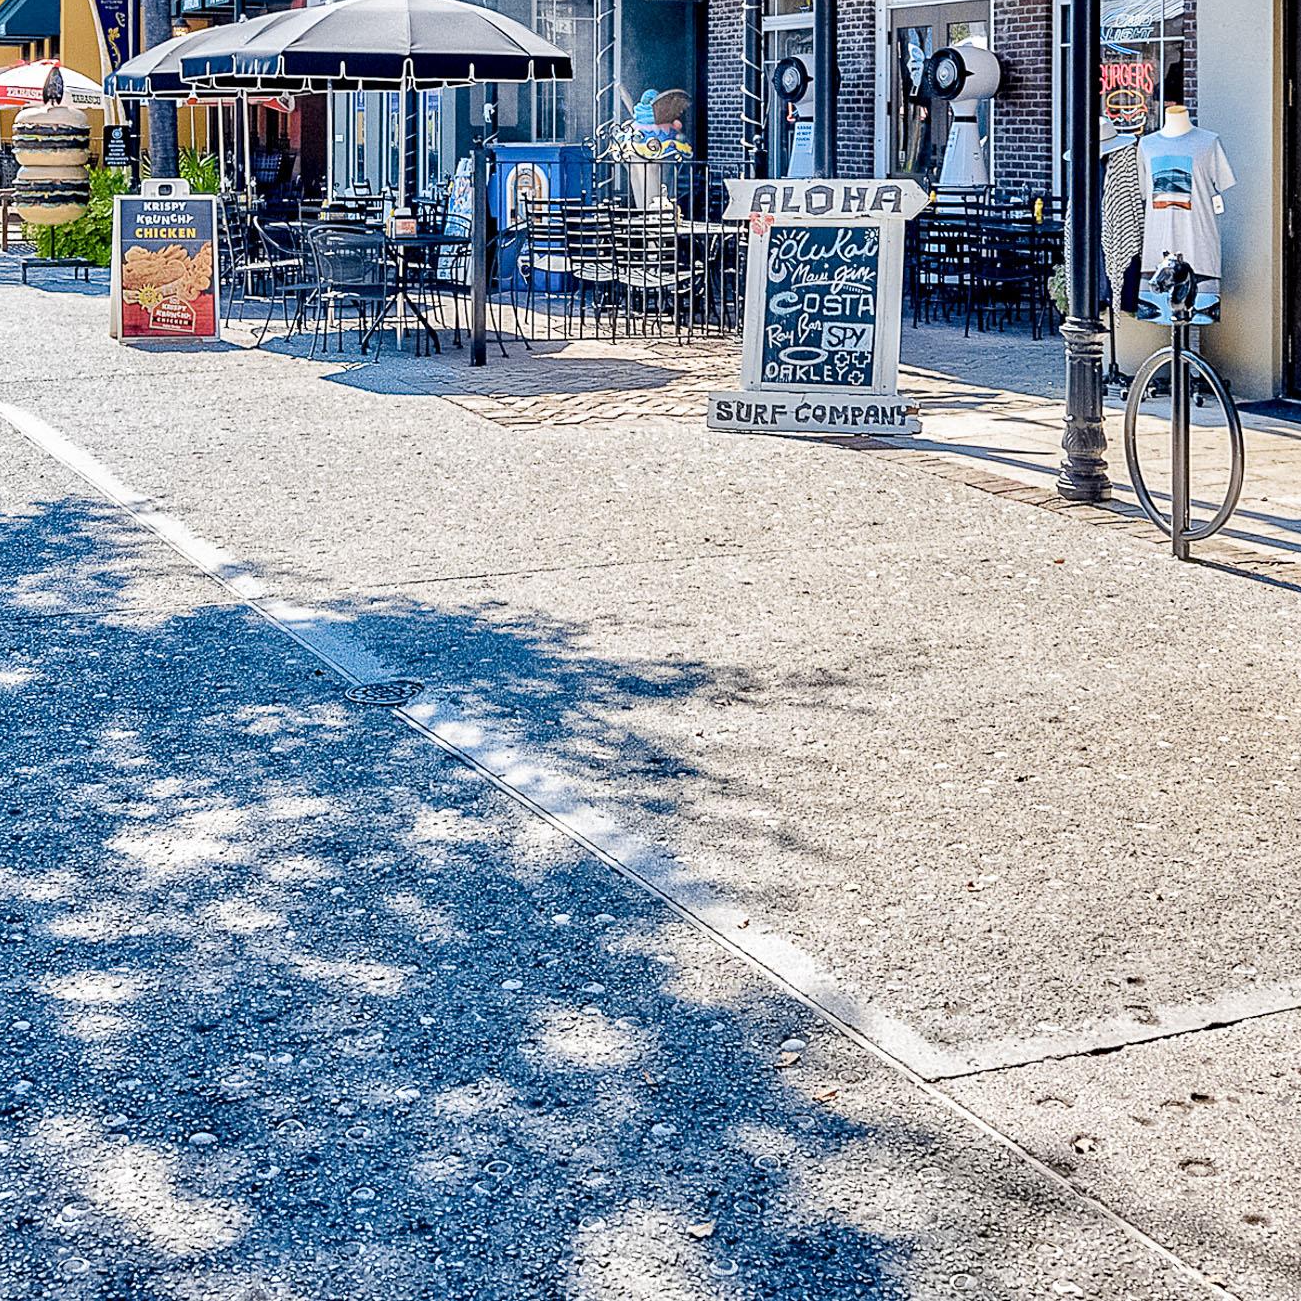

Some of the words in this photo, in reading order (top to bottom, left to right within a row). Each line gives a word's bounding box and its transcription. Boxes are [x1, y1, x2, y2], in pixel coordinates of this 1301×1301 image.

[6, 87, 44, 99] TABASC
[143, 202, 187, 212] KRISPY
[750, 184, 902, 215] ALOHA
[136, 213, 194, 225] KRUNCHY
[135, 228, 196, 238] CHICKEN
[770, 291, 874, 317] COSTA
[827, 327, 867, 350] SPY
[765, 363, 850, 383] OAKLEY
[716, 400, 787, 426] SURF
[795, 403, 909, 427] COMPANY
